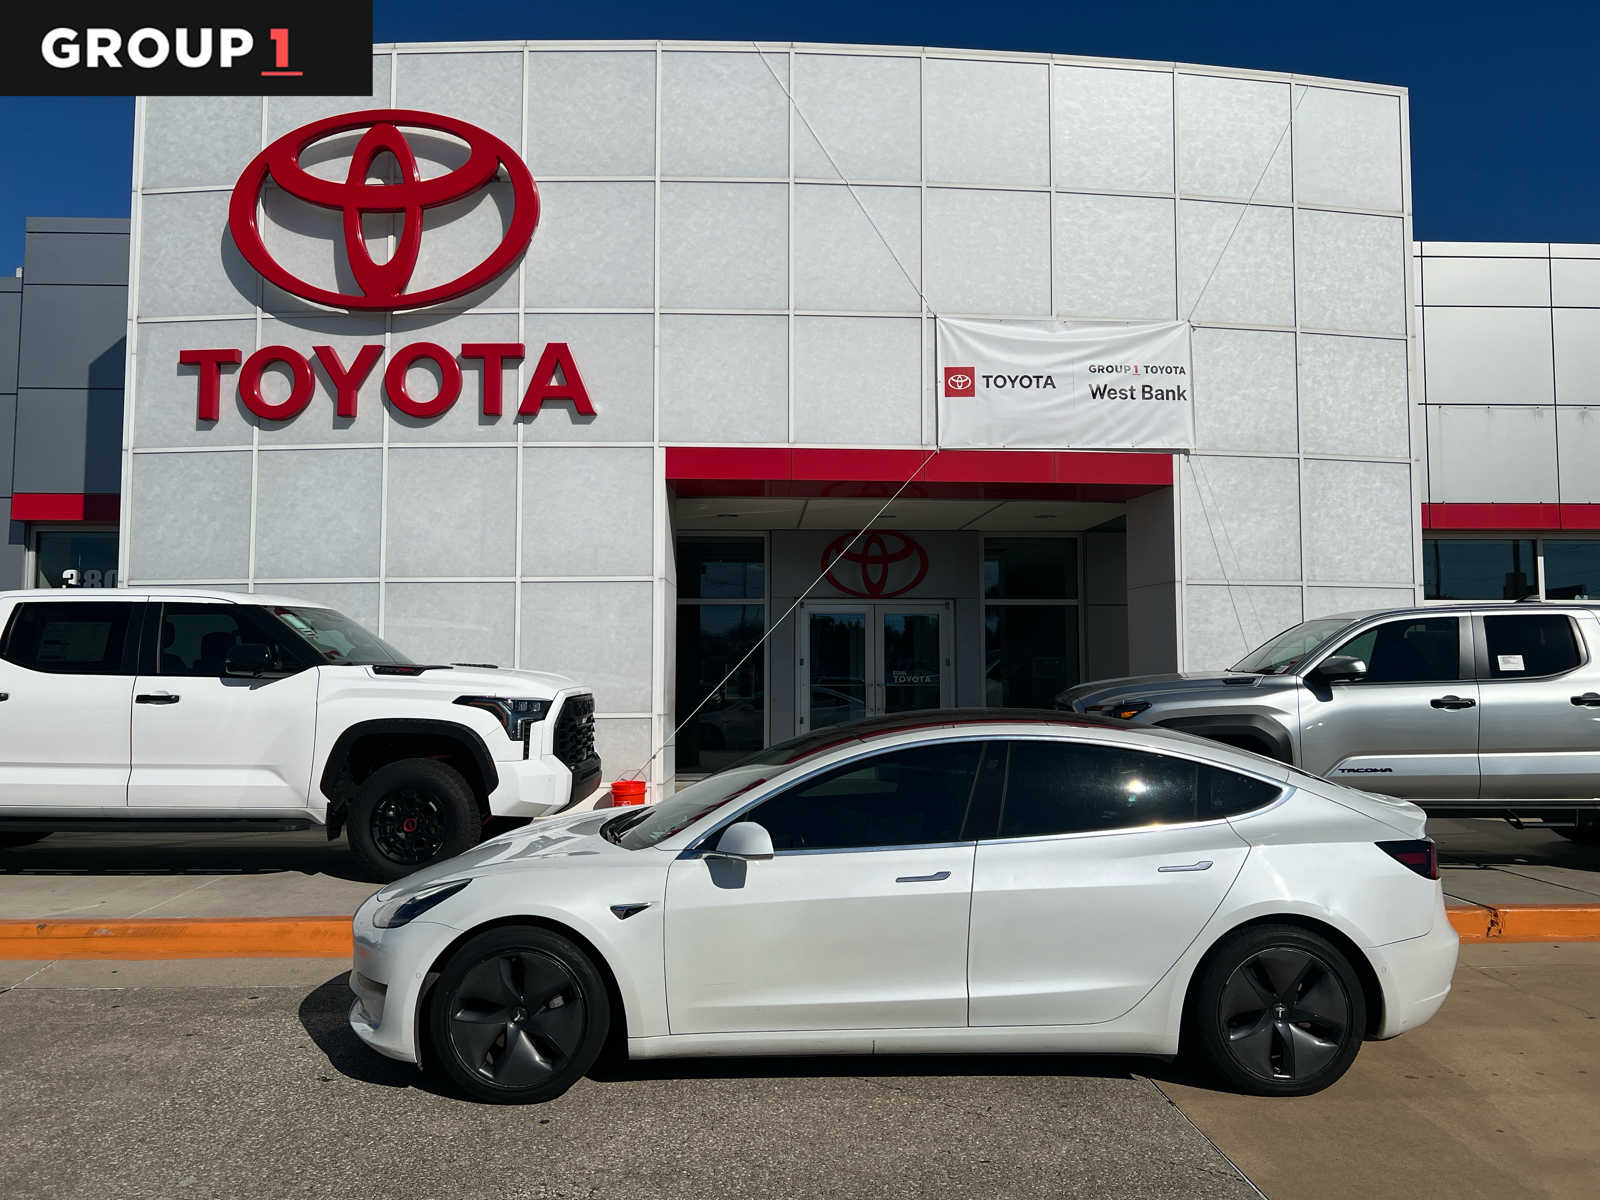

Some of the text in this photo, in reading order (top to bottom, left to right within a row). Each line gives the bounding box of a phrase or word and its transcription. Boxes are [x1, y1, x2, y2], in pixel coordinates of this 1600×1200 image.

[1088, 364, 1131, 374] GROUP
[1143, 364, 1186, 375] TOYOTA
[179, 342, 596, 421] TOYOTA
[982, 375, 1056, 389] TOYOTA
[1089, 384, 1187, 401] West Bank
